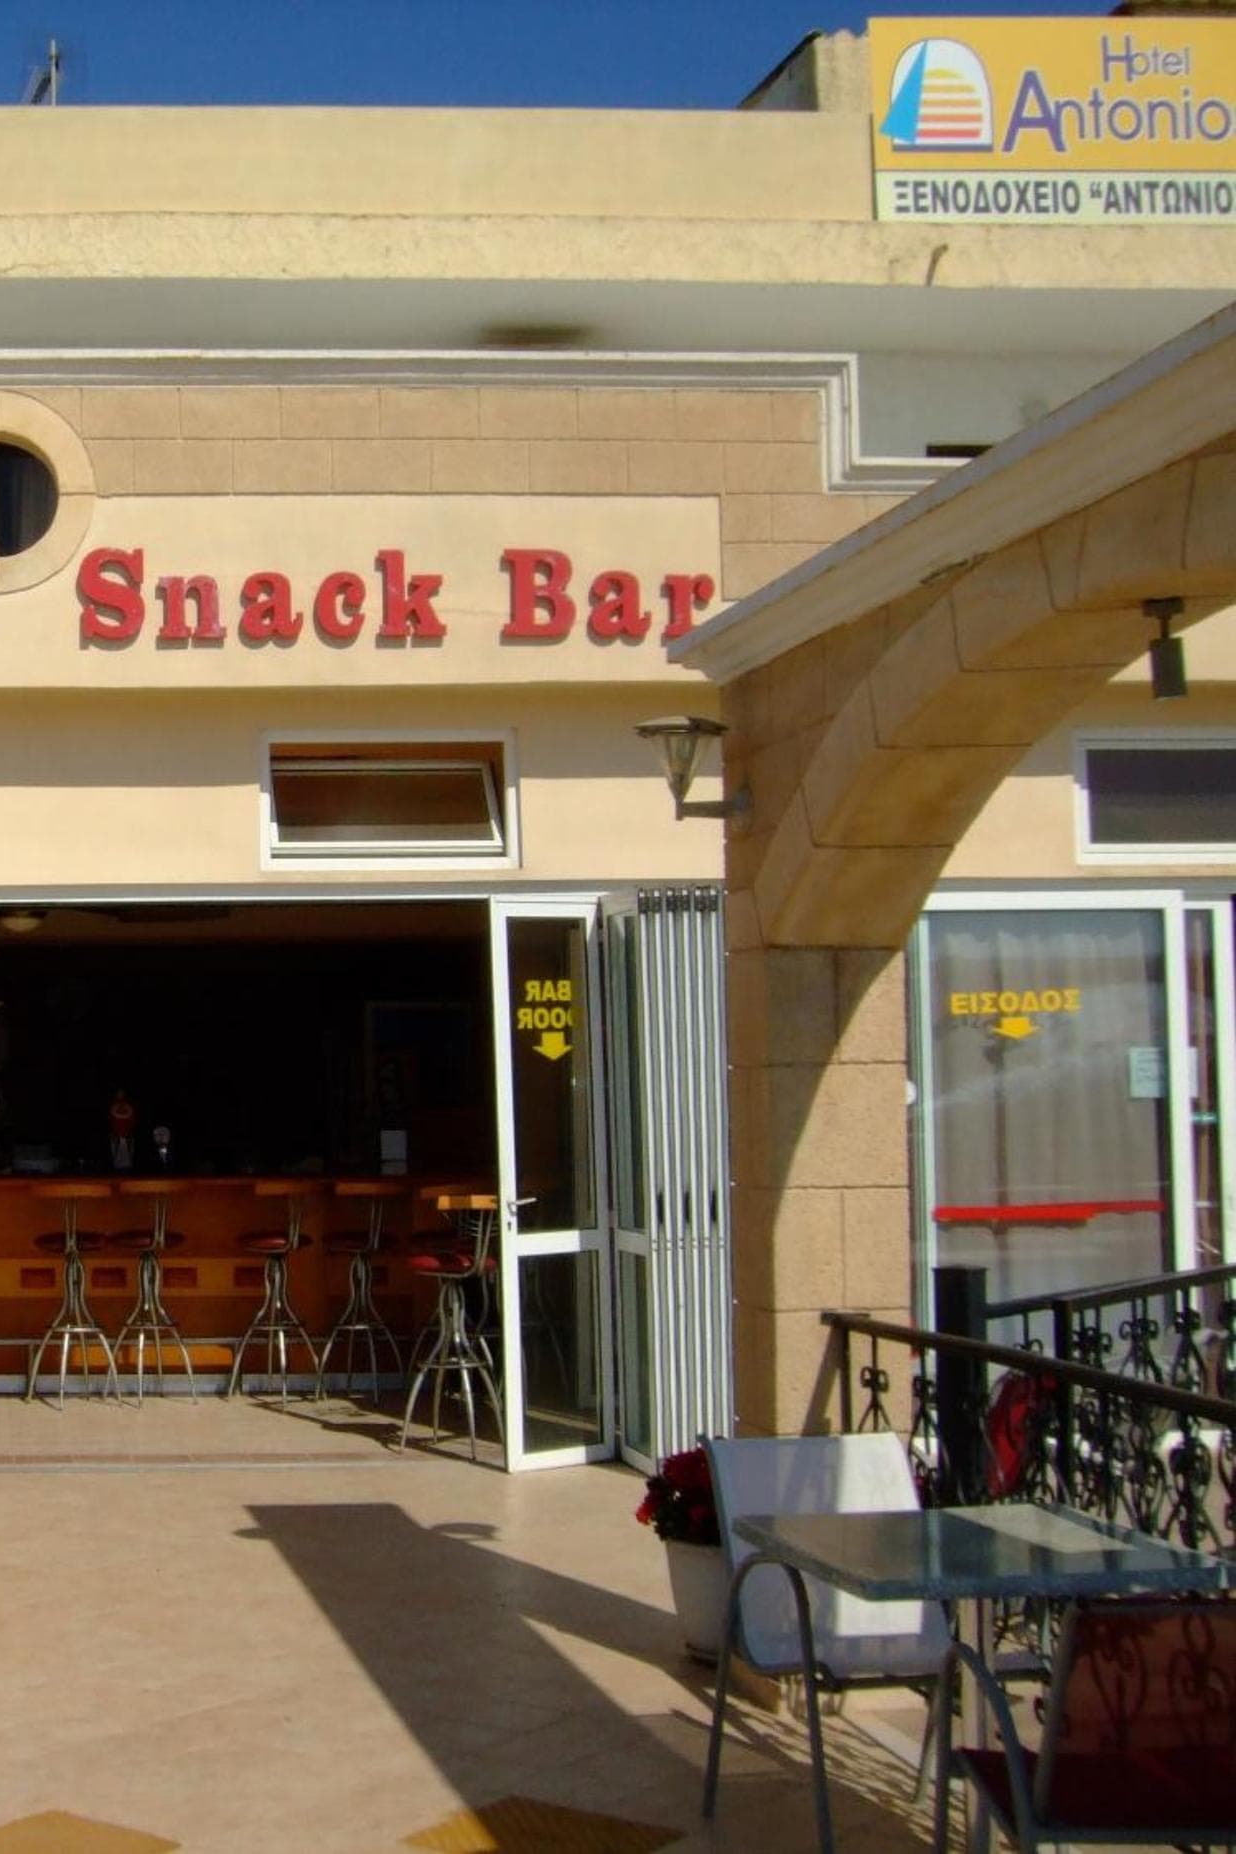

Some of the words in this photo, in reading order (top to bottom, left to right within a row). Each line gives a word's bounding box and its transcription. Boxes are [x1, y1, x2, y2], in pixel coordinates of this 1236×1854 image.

[1101, 35, 1190, 83] Hotel
[1001, 69, 1236, 153] Antonio
[894, 179, 1081, 215] ΞΕΝΟΔΟΧΕΙΟ
[1089, 179, 1236, 215] “ΑΝΤΩΝΙΟ
[76, 547, 449, 647] Snack
[501, 548, 717, 646] Bar
[951, 988, 1081, 1015] ΕΙΣΟΔΟΣ
